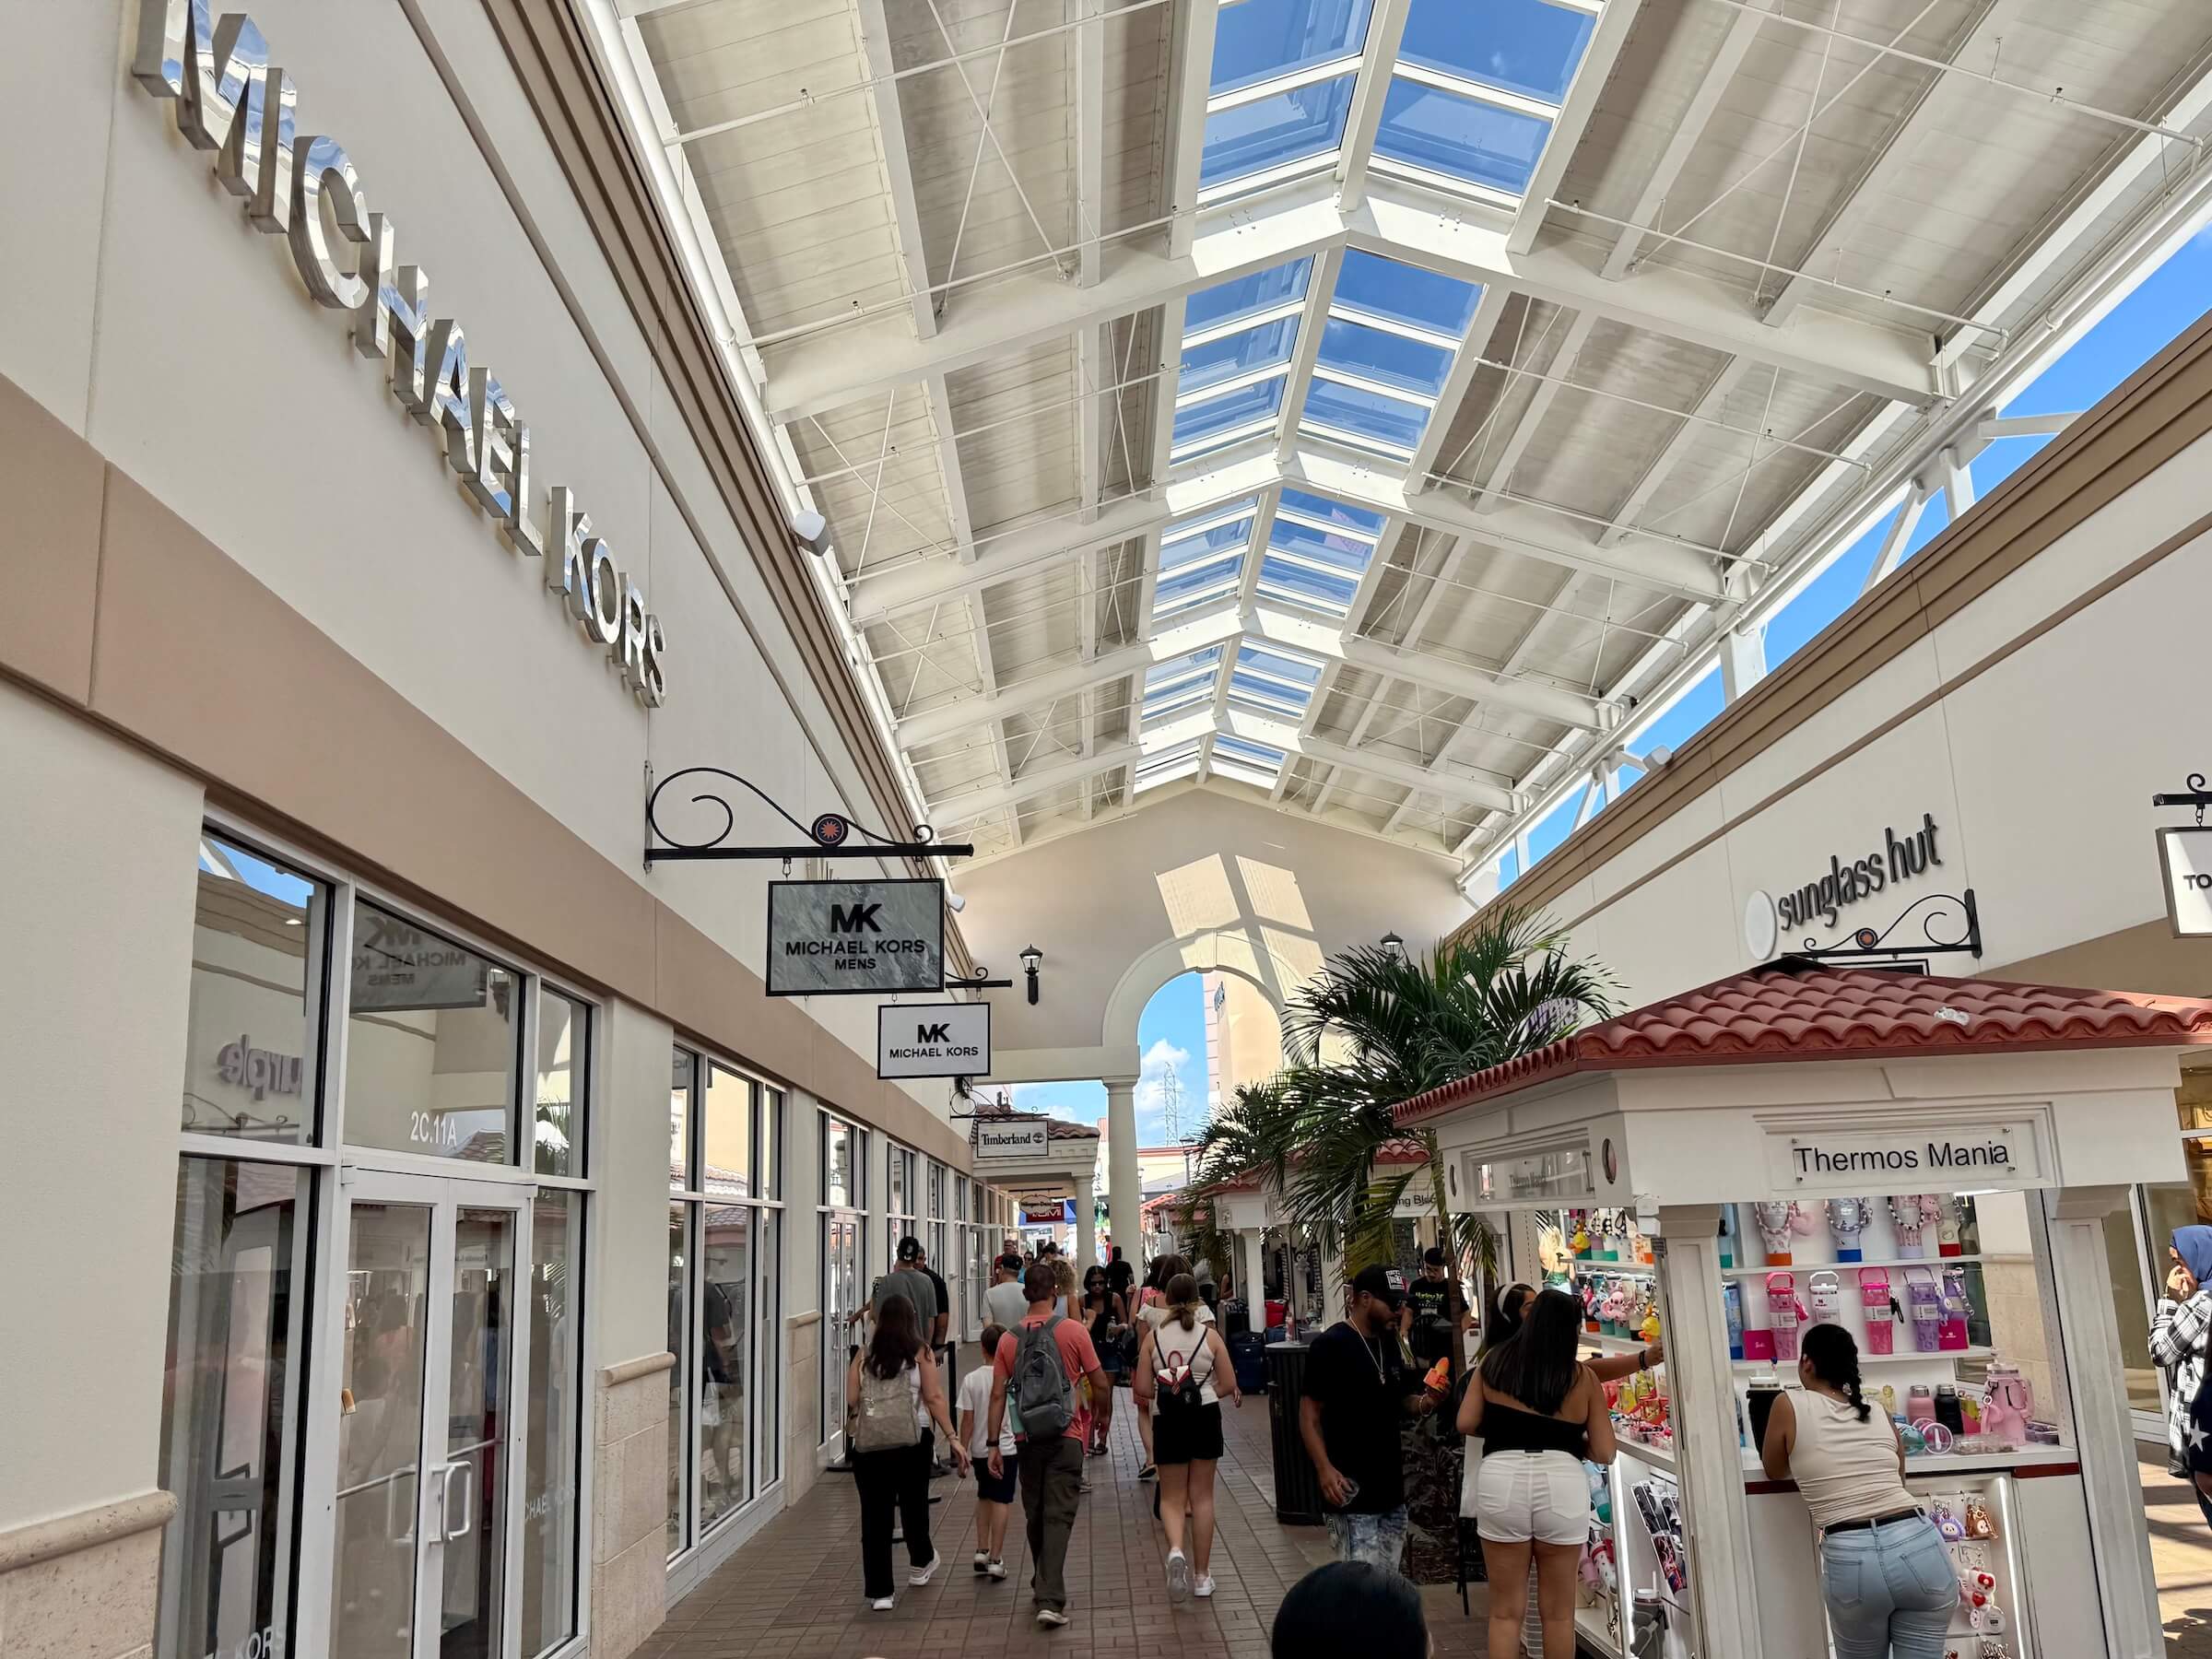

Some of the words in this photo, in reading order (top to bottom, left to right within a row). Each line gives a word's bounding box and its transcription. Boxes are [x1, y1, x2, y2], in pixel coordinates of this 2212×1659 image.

[133, 0, 542, 557] MICHAEL
[547, 486, 666, 709] KORS
[1778, 854, 1885, 931] sunglass
[1885, 813, 1942, 883] hut
[831, 903, 882, 933] MK
[785, 940, 868, 956] MICHAEL
[875, 939, 925, 955] KORS
[835, 958, 877, 971] MENS
[917, 1023, 950, 1043] MK
[889, 1048, 942, 1059] MICHAEL
[947, 1046, 979, 1057] KORS
[410, 1111, 457, 1146] 2C.11A
[981, 1133, 1031, 1146] Timberland
[1793, 1147, 1919, 1172] Thermos
[1927, 1140, 2009, 1167] Mania
